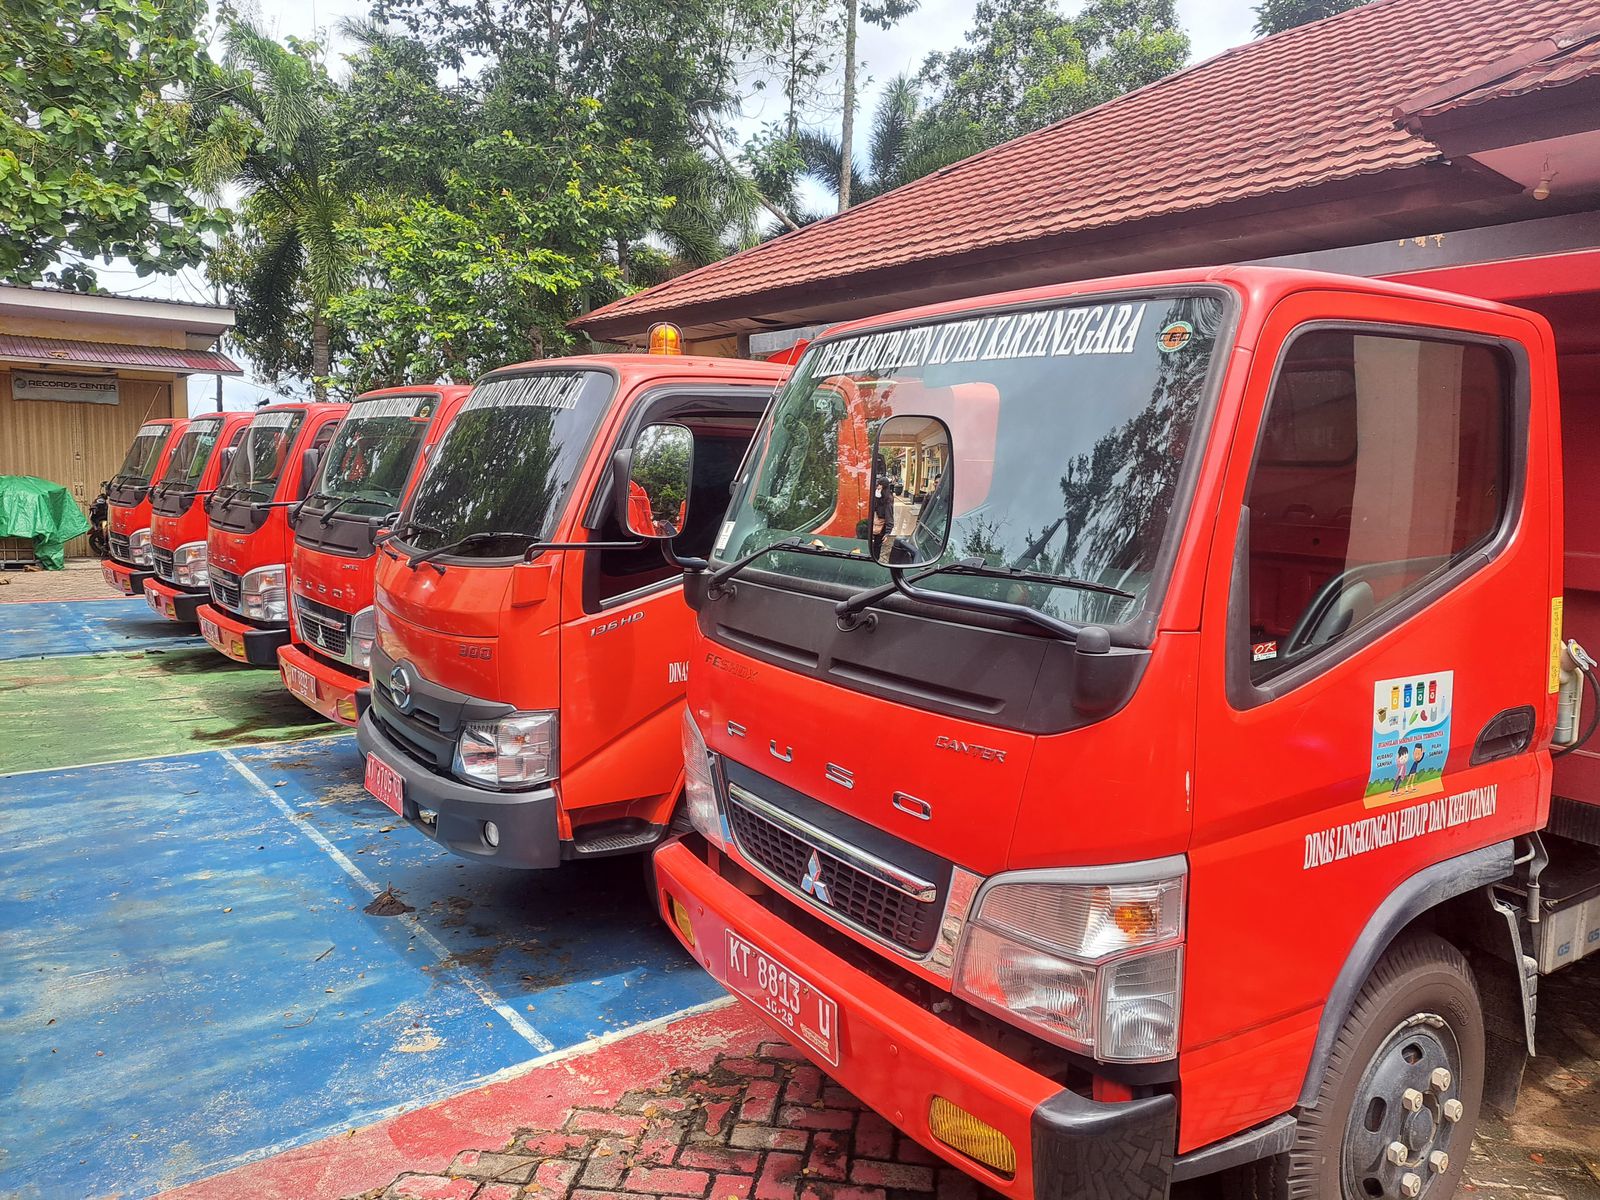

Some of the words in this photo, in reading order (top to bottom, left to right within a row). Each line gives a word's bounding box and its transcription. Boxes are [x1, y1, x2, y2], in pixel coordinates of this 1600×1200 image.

[845, 325, 942, 373] KABUPATEN
[928, 318, 987, 365] KUTAI
[980, 303, 1146, 360] KARTANEGARA
[28, 380, 77, 388] RECORDS
[80, 382, 116, 390] CENTER
[591, 620, 619, 637] 136
[621, 611, 645, 626] HD
[458, 643, 493, 660] 300
[1255, 641, 1276, 654] OK
[935, 735, 1007, 763] CANTER
[727, 720, 932, 821] FUSO
[1303, 828, 1335, 870] DINAS
[1335, 810, 1399, 860] LINGKUNGAN
[1398, 803, 1429, 841] HIDUP
[1428, 798, 1448, 832] DAN
[1447, 784, 1498, 827] KEHUTANAN
[729, 936, 751, 977] KT
[757, 956, 801, 1015] 8813
[818, 998, 830, 1040] U
